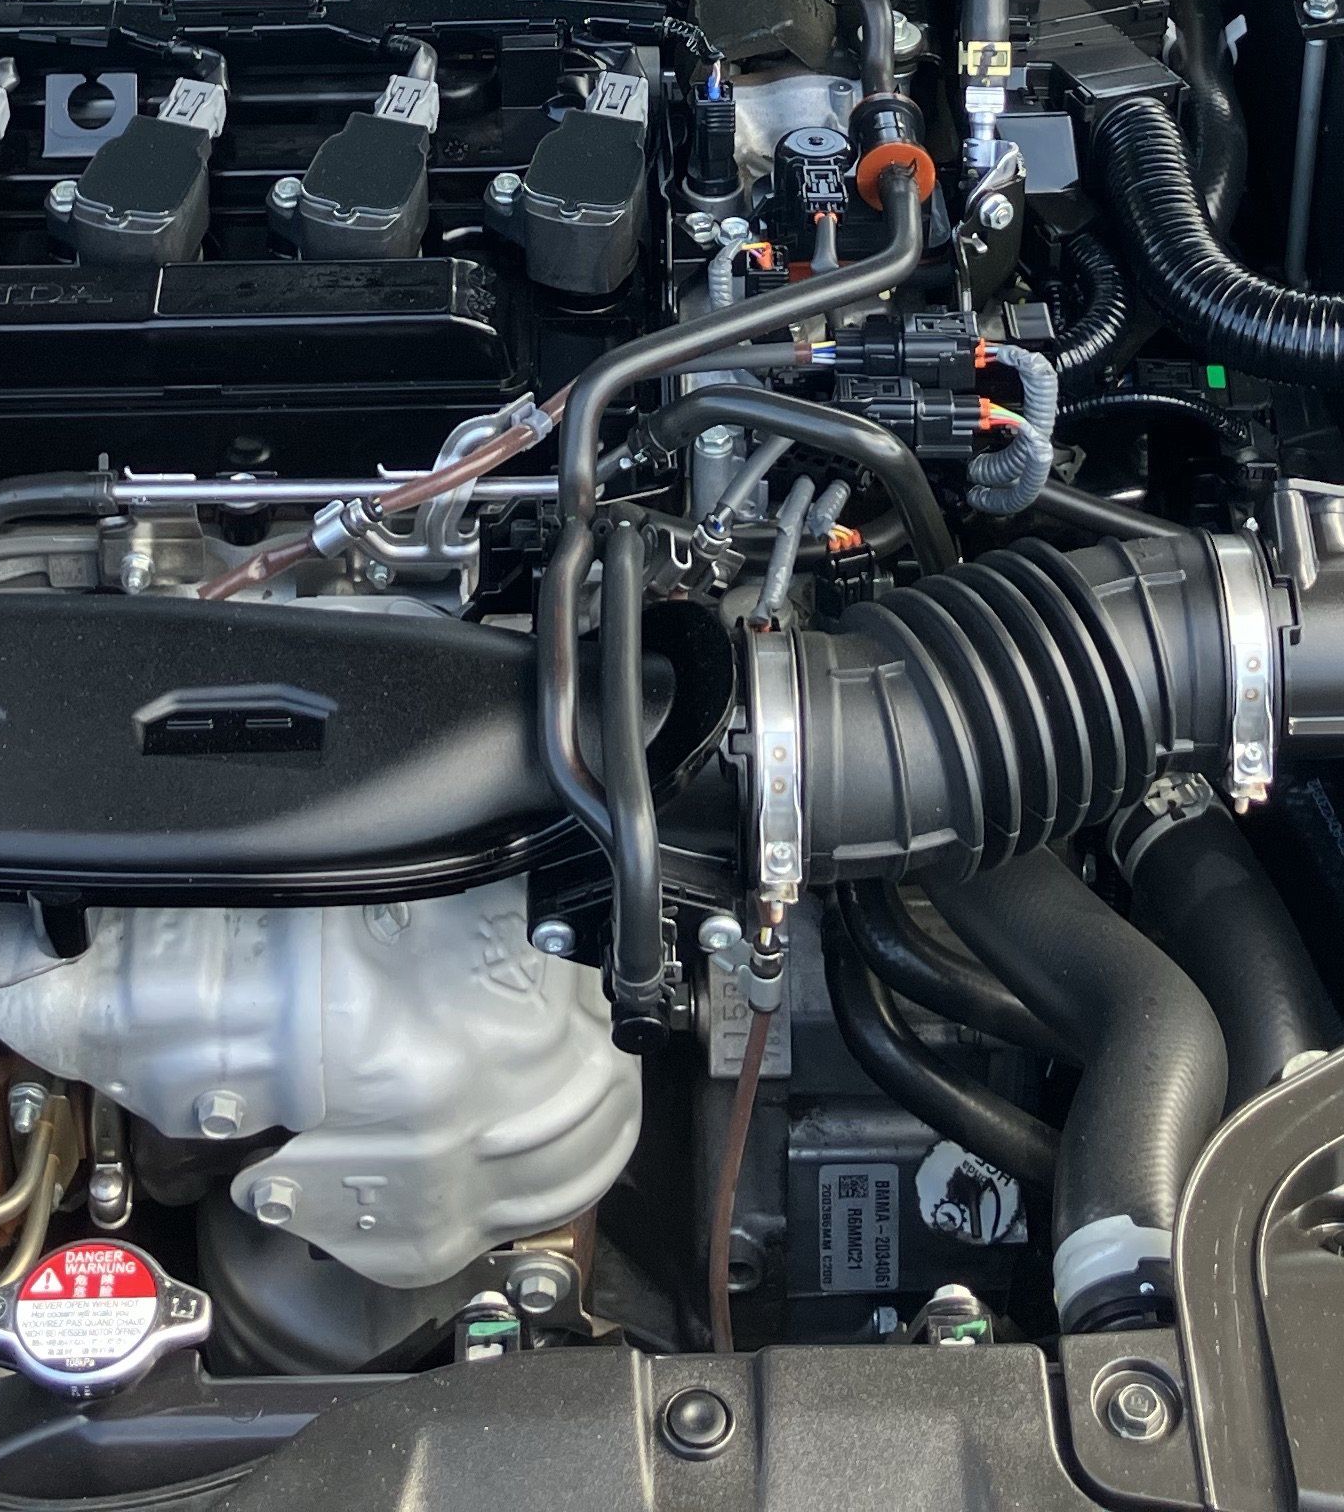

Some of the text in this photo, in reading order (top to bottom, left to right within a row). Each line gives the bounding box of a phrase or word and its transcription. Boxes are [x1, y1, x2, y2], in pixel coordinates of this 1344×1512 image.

[65, 1250, 124, 1263] DANGER
[65, 1261, 136, 1275] WARNUNG
[32, 1299, 139, 1310] NEVER OPEN WHEN HOT
[65, 1319, 83, 1328] PAS
[84, 1318, 114, 1327] QUAND
